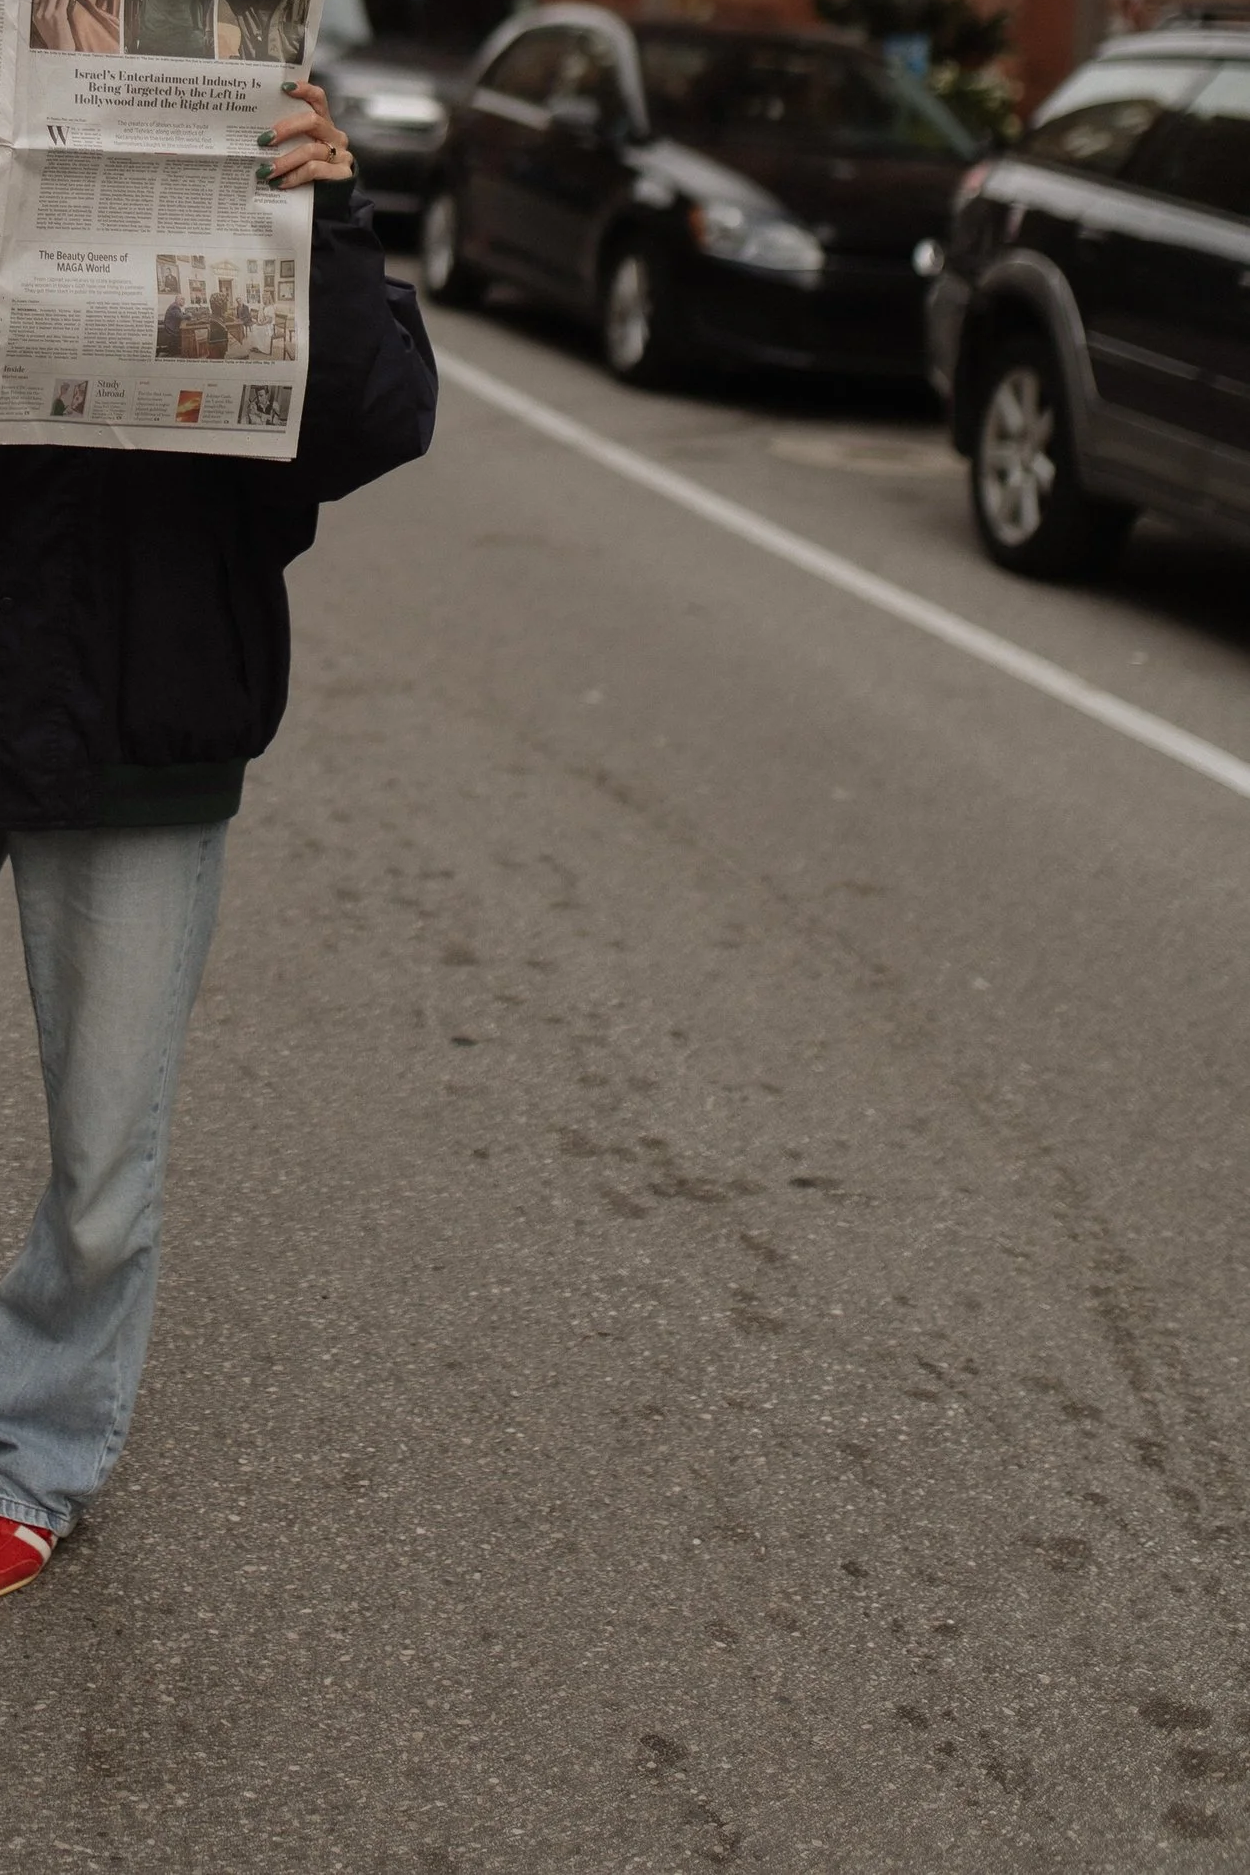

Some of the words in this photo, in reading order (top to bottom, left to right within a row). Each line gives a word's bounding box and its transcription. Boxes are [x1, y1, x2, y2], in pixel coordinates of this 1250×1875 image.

[119, 70, 199, 86] Entertainment
[202, 73, 248, 90] Industry
[252, 78, 261, 89] Is
[88, 82, 121, 95] Being
[124, 83, 172, 98] Targeted
[174, 85, 186, 100] by
[190, 86, 207, 98] the
[210, 87, 232, 100] Left
[235, 89, 246, 100] in
[74, 94, 135, 108] Hollywood
[137, 96, 157, 108] and
[160, 97, 178, 109] the
[180, 98, 209, 113] Right
[212, 100, 222, 112] at
[225, 102, 258, 113] Home
[39, 250, 55, 260] The
[57, 251, 85, 263] Beauty
[87, 252, 117, 263] Queens
[120, 253, 128, 262] of
[57, 263, 83, 273] MAGA
[86, 263, 110, 273] World
[3, 364, 25, 373] Inside
[97, 380, 119, 391] Study
[95, 389, 125, 398] Abroad
